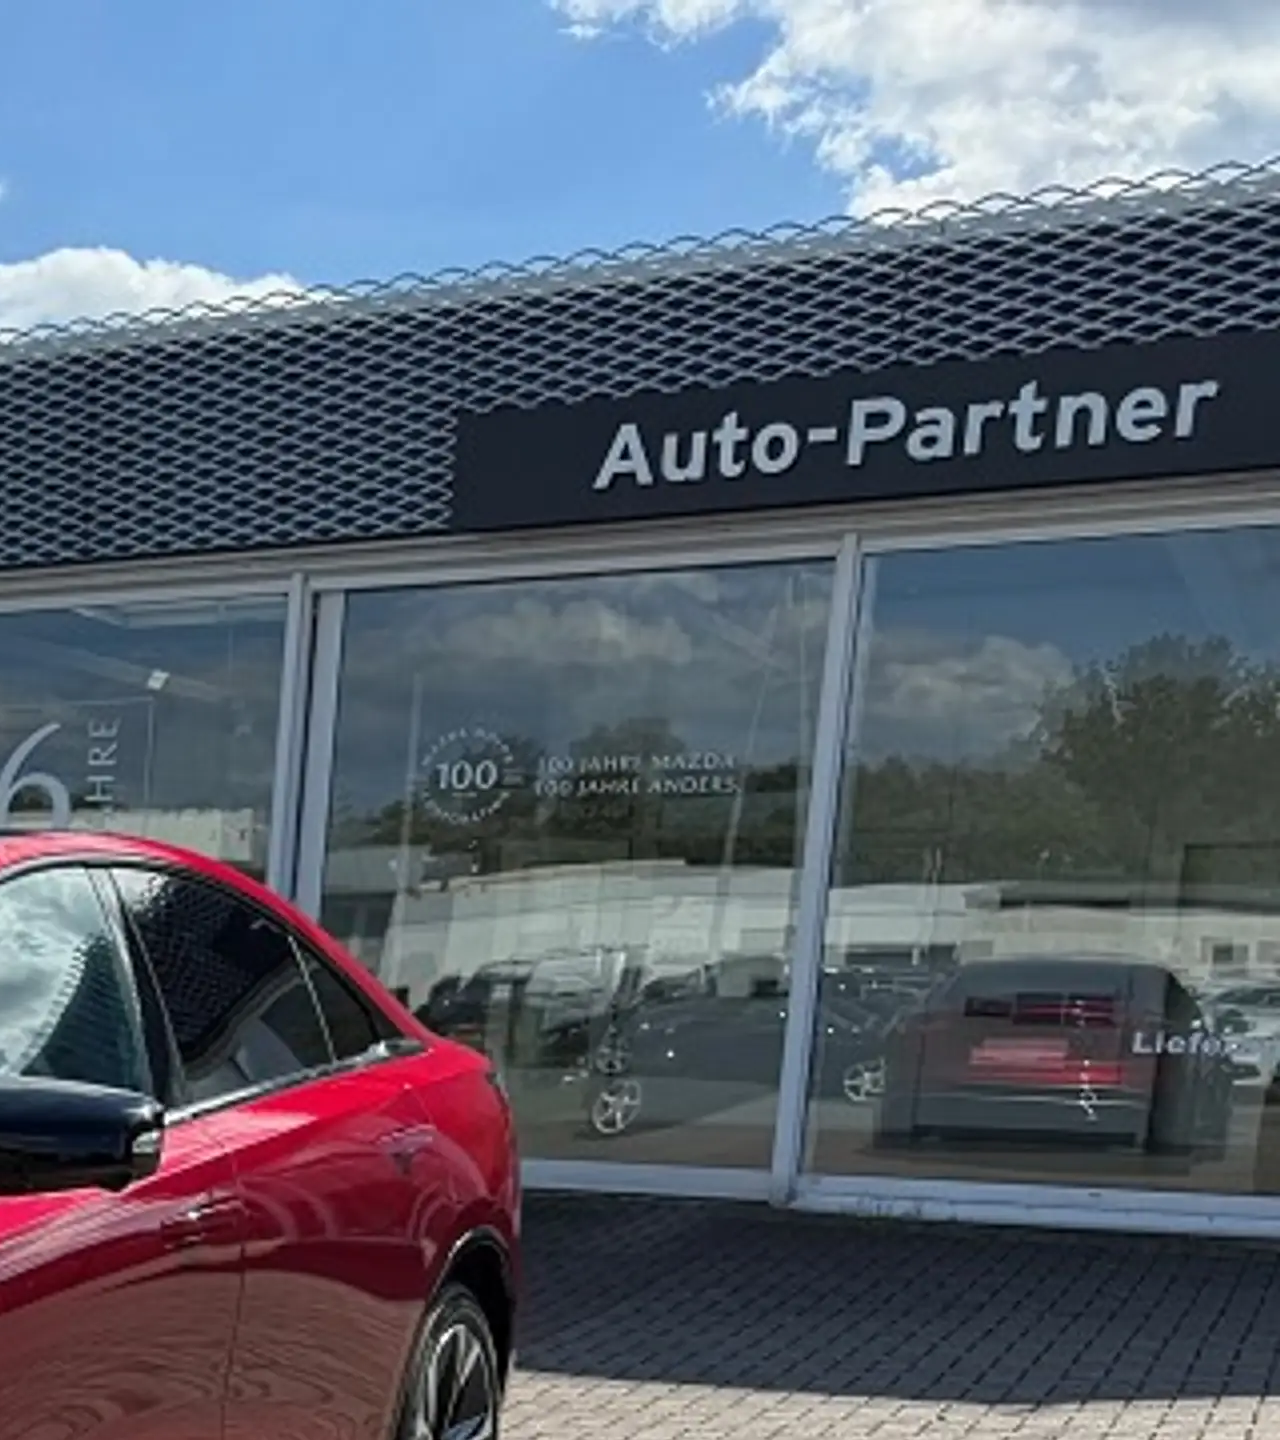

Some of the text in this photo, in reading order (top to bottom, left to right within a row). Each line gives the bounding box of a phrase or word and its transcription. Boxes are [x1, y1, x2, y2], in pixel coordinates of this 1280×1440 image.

[592, 379, 1220, 490] Auto-Partner
[85, 716, 122, 814] HRE
[436, 759, 497, 789] 100
